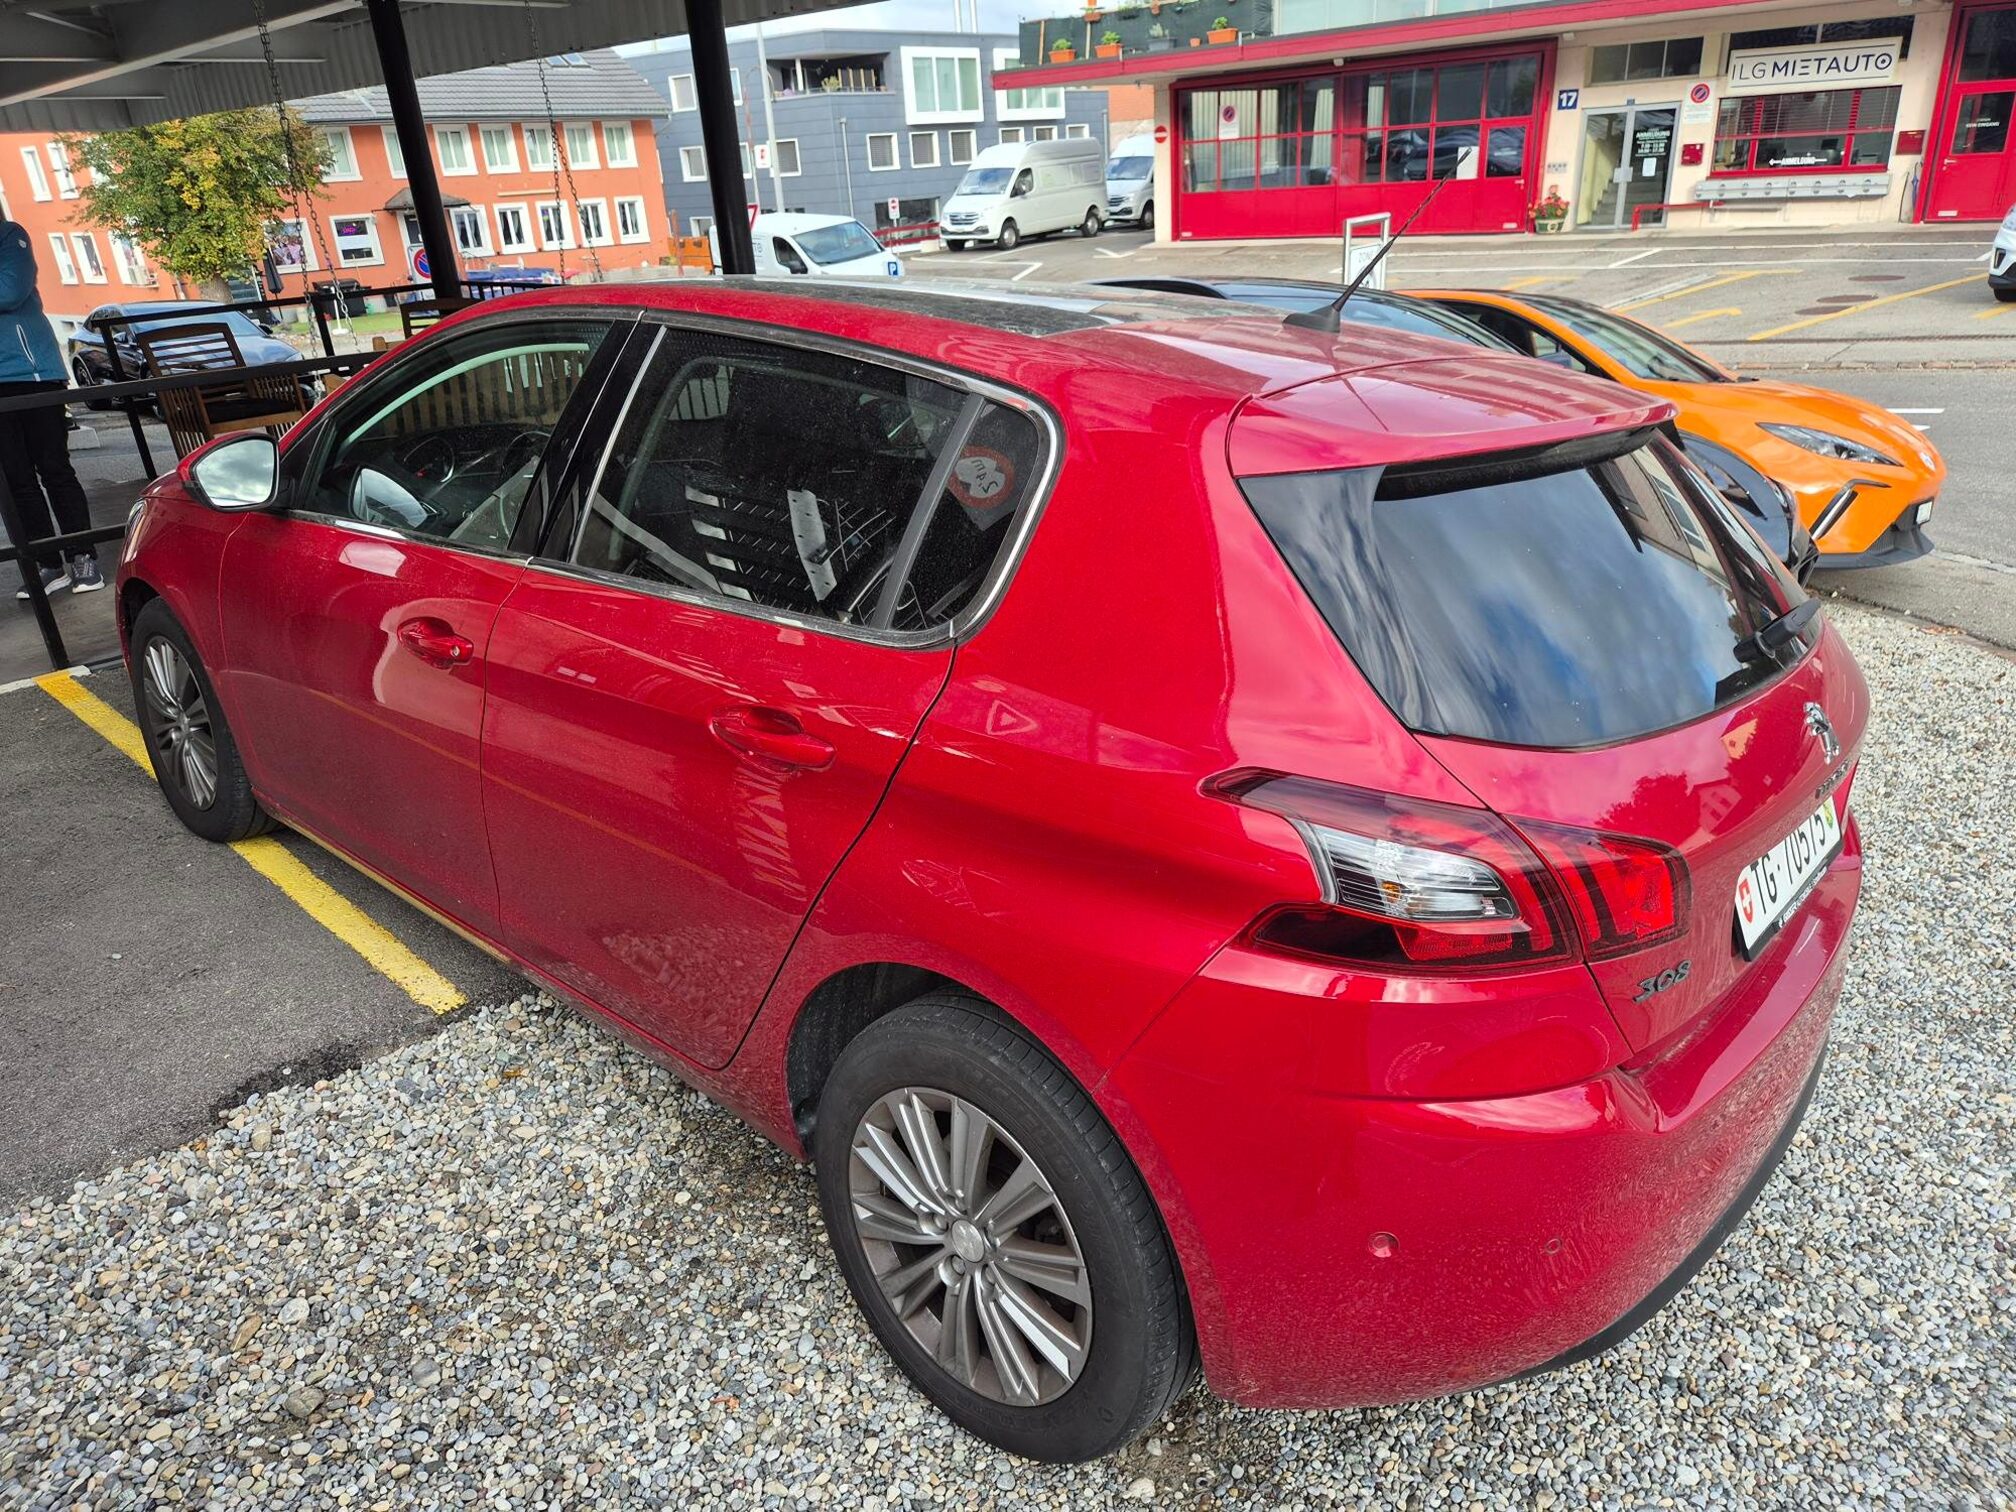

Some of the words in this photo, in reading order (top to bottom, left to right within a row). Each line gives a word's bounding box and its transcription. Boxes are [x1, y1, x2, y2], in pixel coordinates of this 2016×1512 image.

[1731, 62, 1767, 81] ILG
[1771, 52, 1893, 78] MIETAUTO
[1559, 91, 1578, 107] 17
[1632, 959, 1691, 1004] 308
